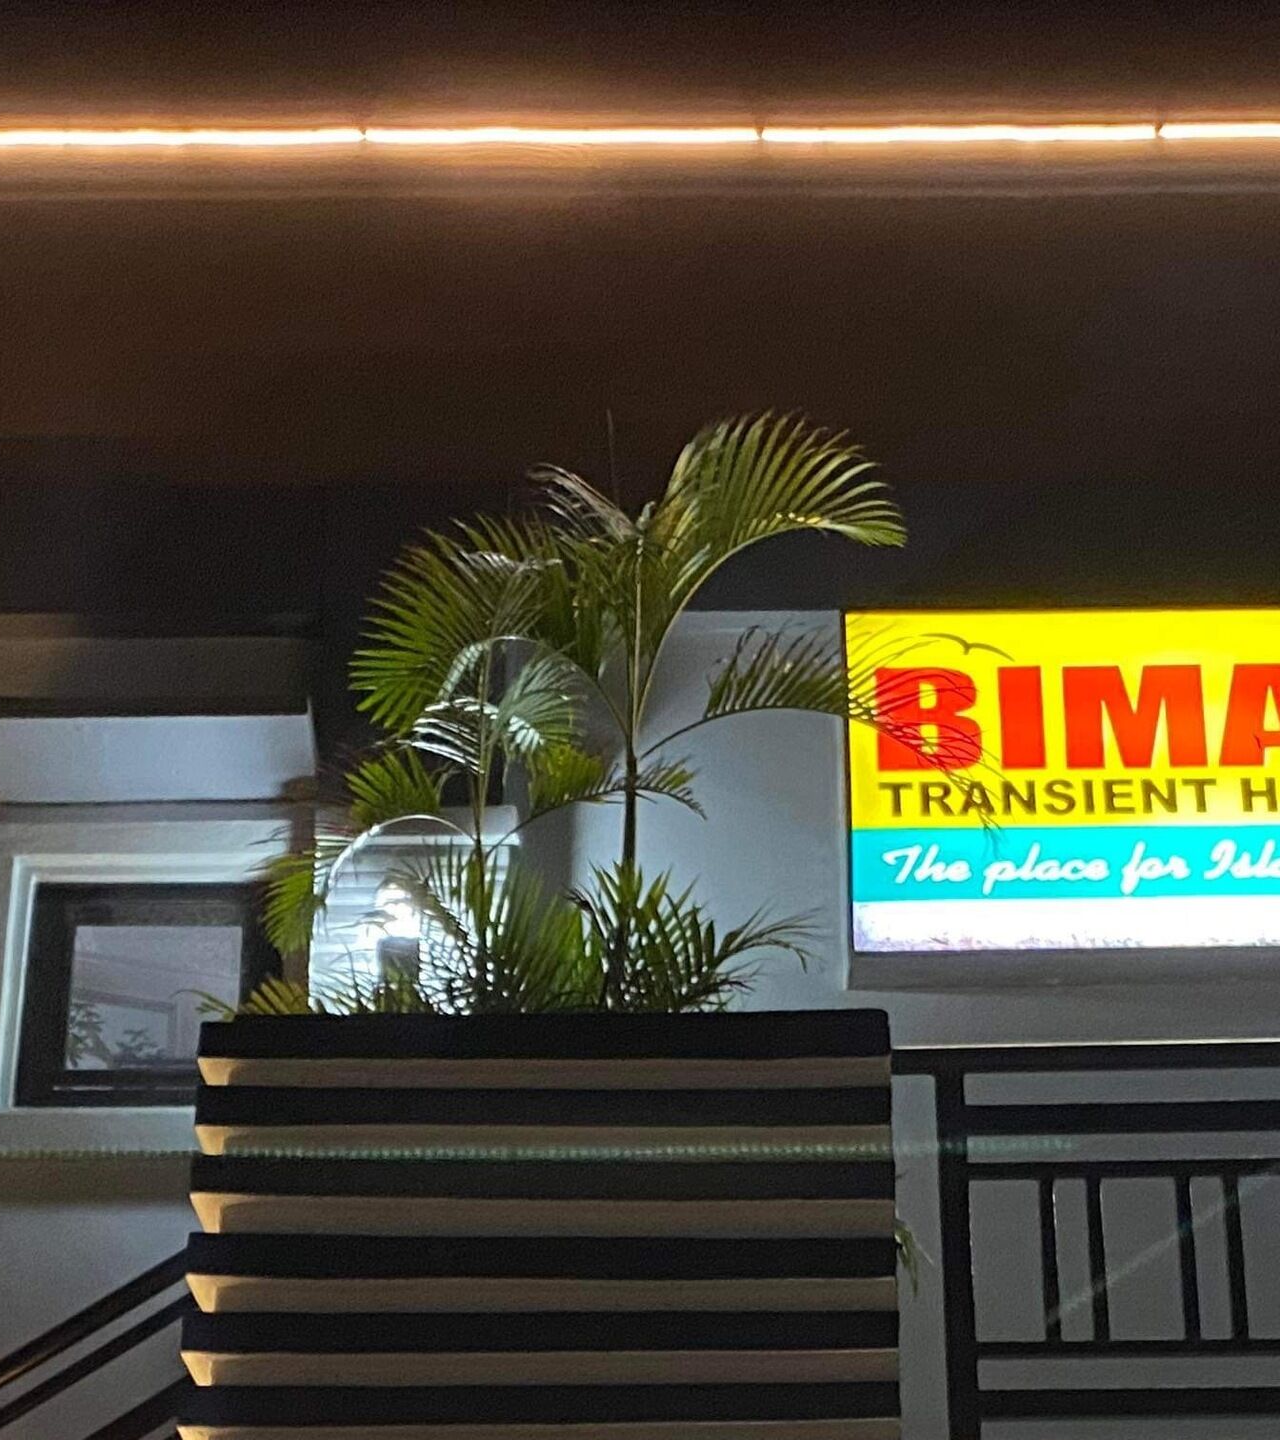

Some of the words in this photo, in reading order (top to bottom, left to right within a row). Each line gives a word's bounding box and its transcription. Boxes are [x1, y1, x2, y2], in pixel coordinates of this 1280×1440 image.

[877, 777, 1218, 818] TRANSIENT
[881, 843, 972, 884] The
[982, 841, 1111, 896] place
[1121, 840, 1192, 896] for
